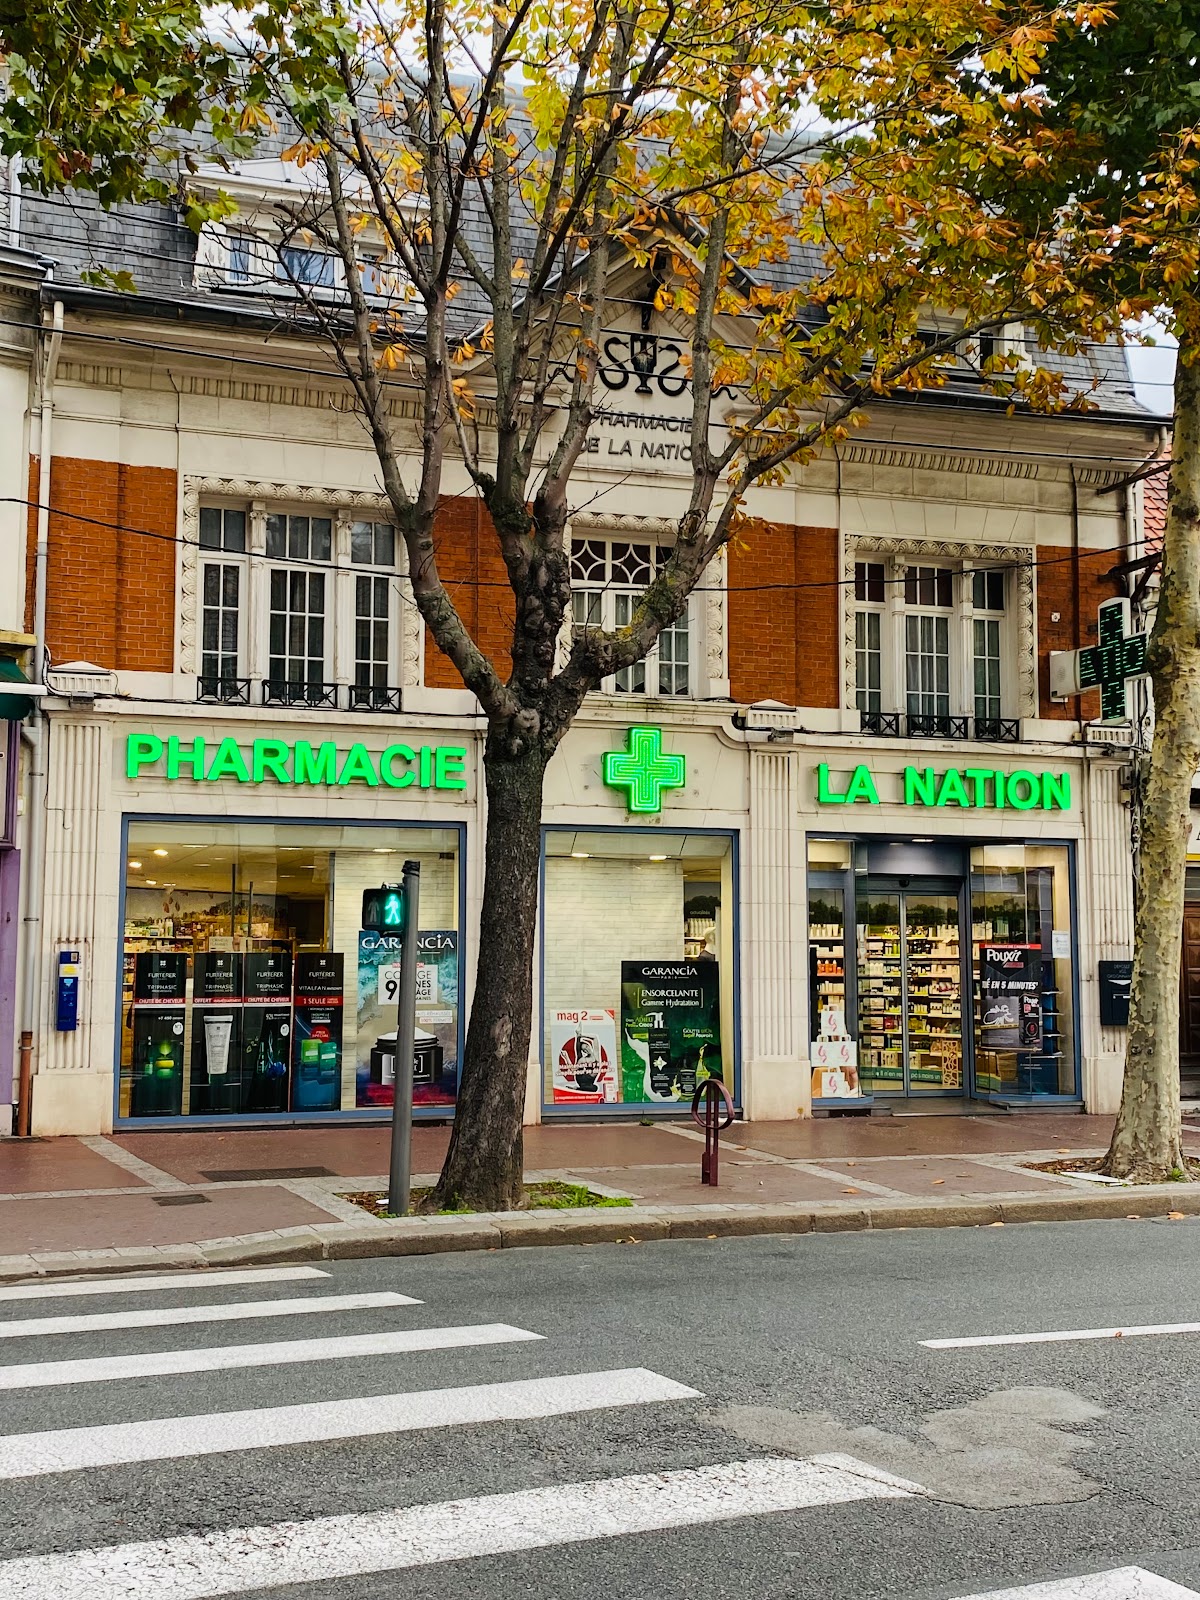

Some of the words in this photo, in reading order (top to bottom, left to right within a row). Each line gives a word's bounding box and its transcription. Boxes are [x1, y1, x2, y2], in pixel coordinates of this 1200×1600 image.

[594, 409, 692, 433] HARMACIE
[608, 438, 632, 456] LA
[640, 441, 692, 461] NATIO
[127, 733, 467, 790] PHARMACIE
[818, 763, 880, 804] LA
[903, 766, 1071, 810] NATION
[986, 949, 1022, 965] Pouxit
[385, 979, 398, 1001] 9
[641, 989, 699, 997] ENSORCELANTE
[665, 998, 699, 1008] Hydratation
[557, 1012, 579, 1024] mag
[581, 1010, 588, 1021] 2
